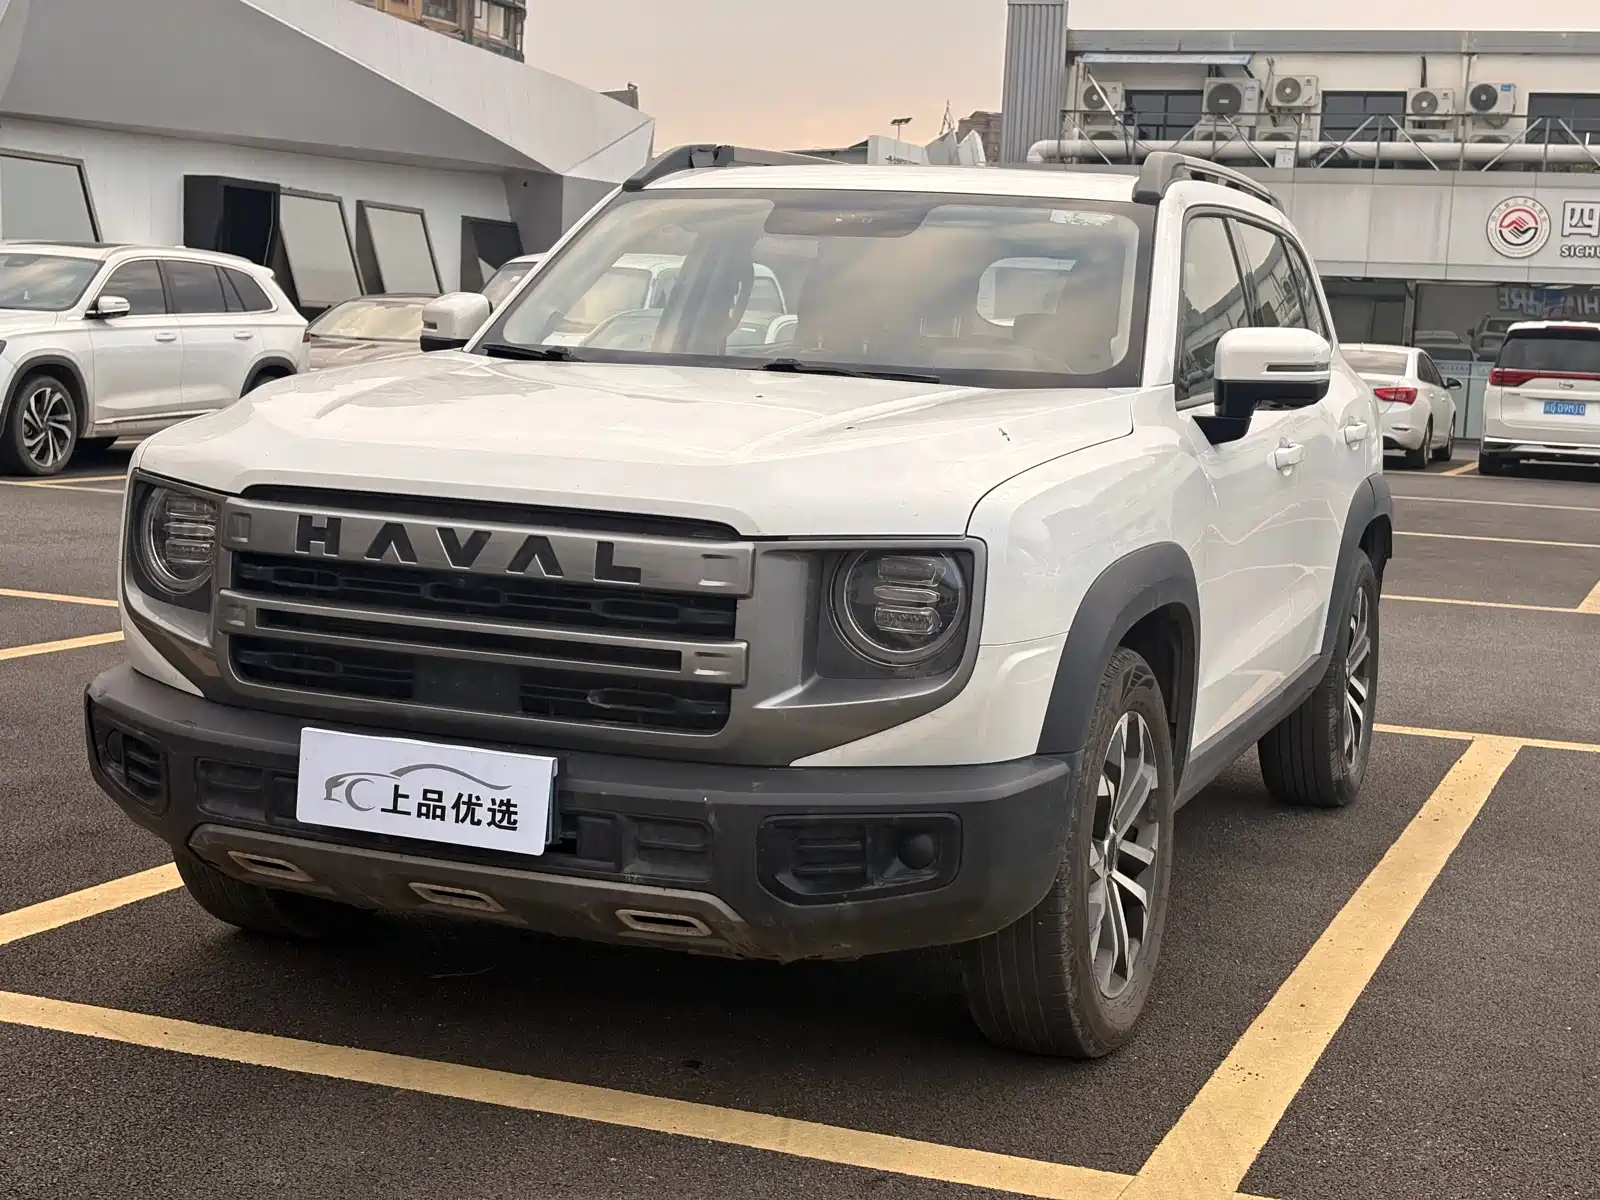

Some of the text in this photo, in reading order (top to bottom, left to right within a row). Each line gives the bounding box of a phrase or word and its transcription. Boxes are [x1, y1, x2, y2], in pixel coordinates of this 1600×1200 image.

[294, 513, 642, 585] HAVAL
[380, 784, 519, 832] 上品优选
